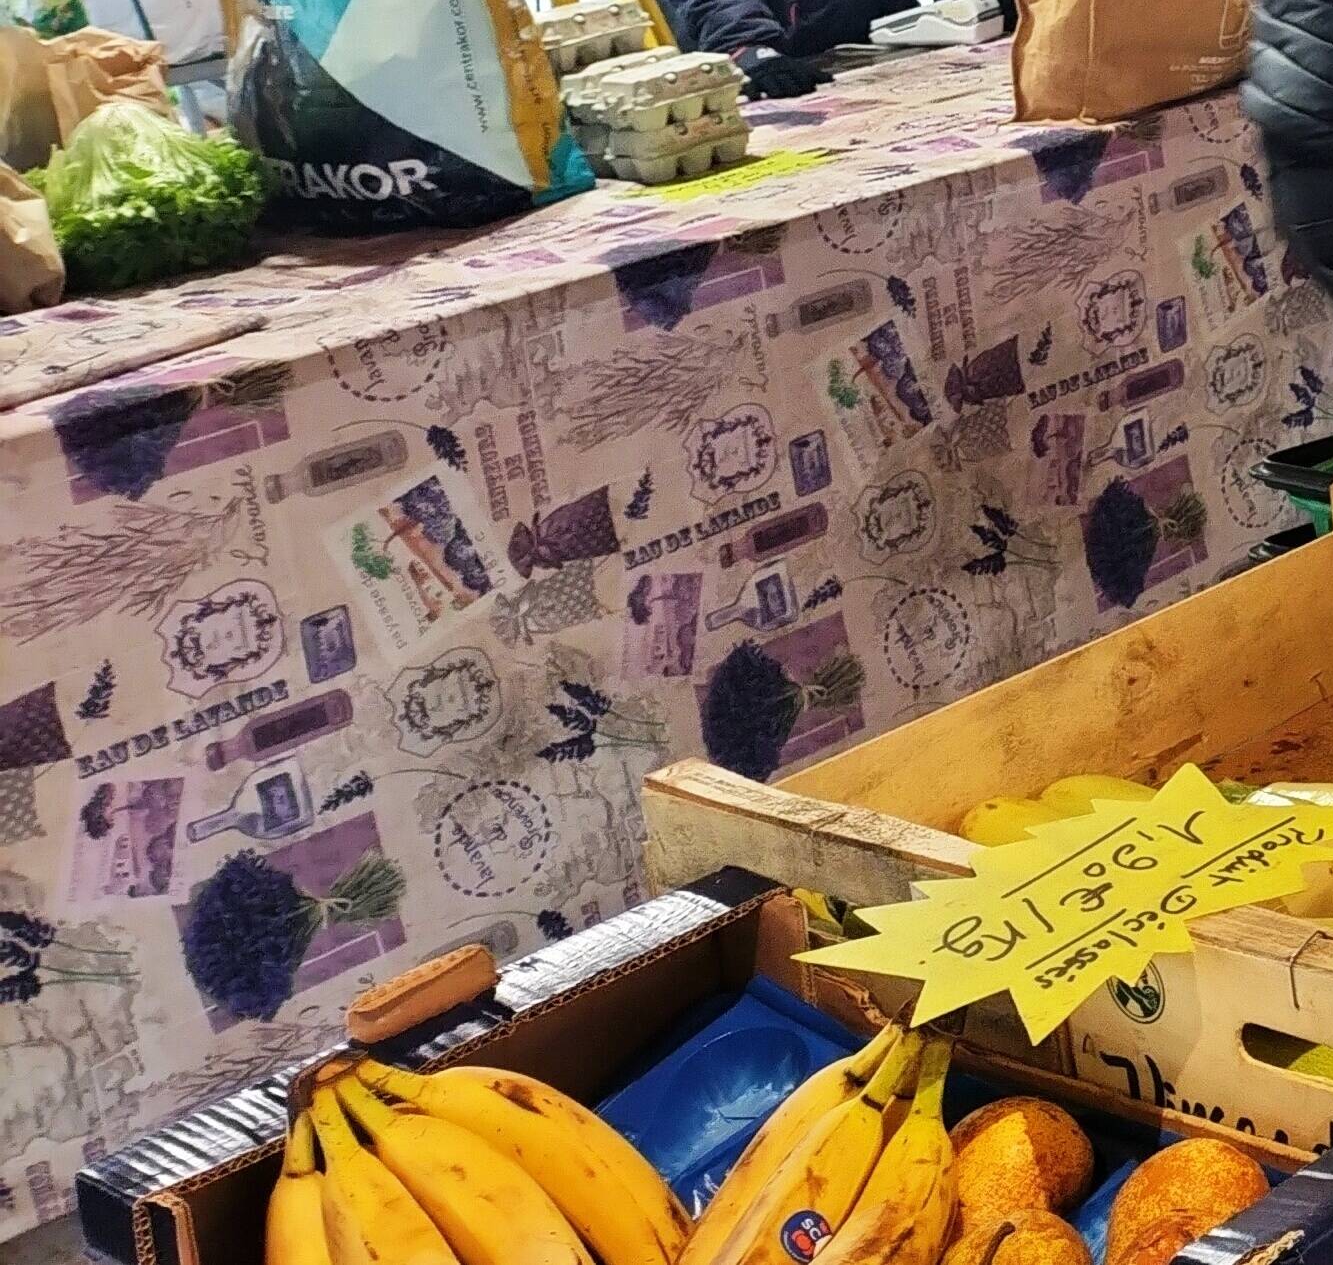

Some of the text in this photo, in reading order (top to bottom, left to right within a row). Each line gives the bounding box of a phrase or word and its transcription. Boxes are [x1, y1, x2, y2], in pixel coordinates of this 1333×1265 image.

[75, 678, 290, 780] EAU DE LAVANDE
[1208, 826, 1326, 888] Produit
